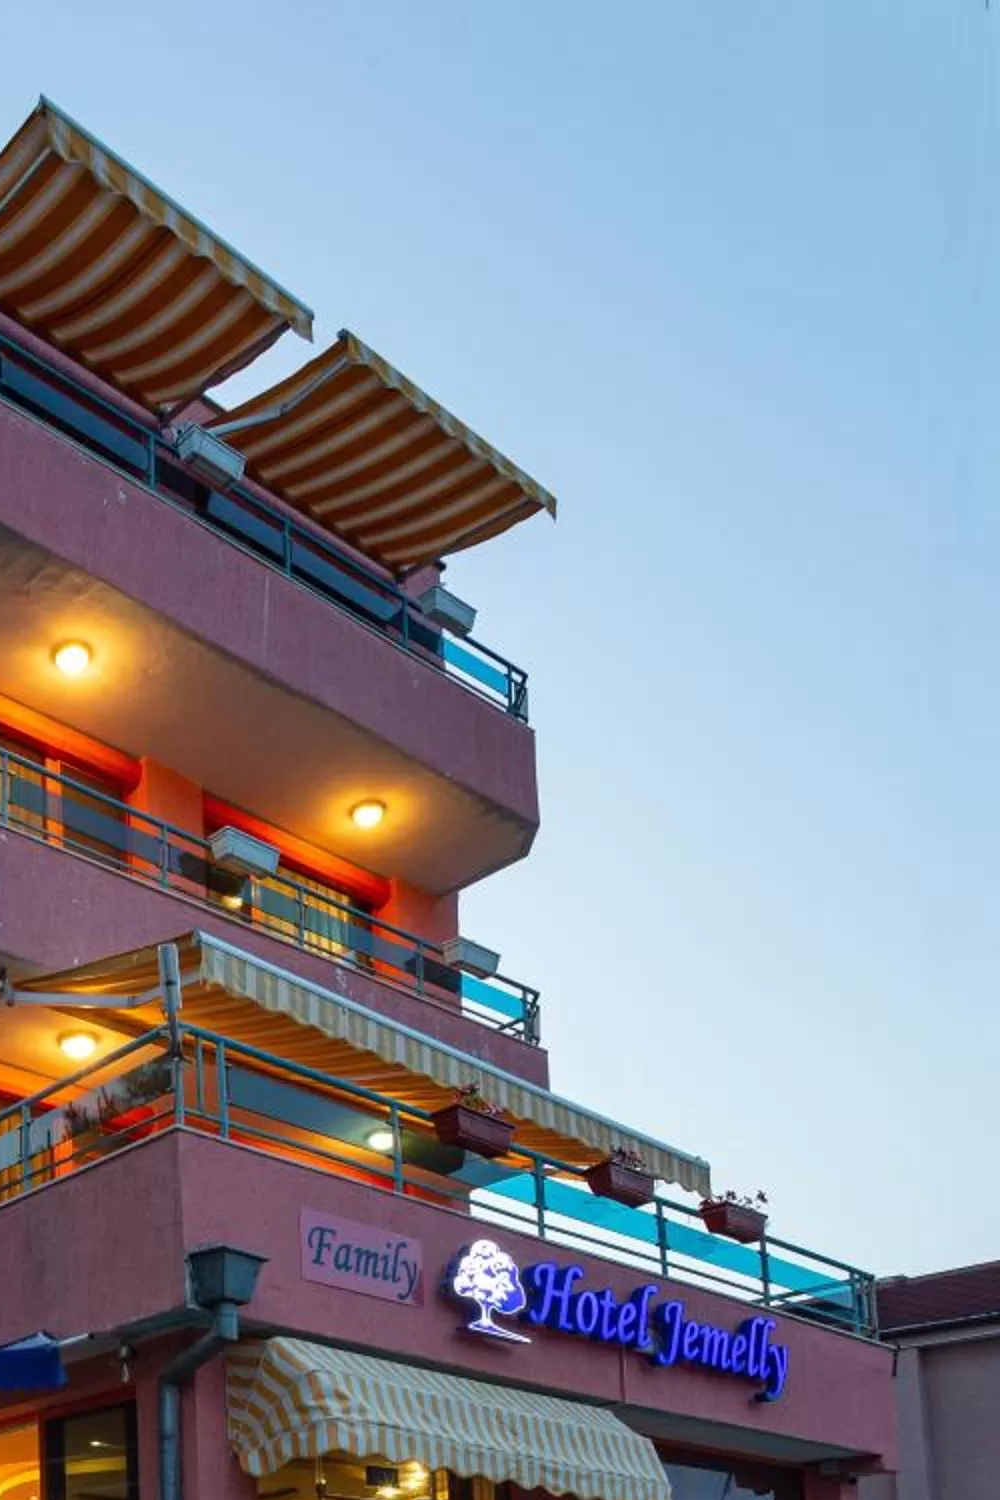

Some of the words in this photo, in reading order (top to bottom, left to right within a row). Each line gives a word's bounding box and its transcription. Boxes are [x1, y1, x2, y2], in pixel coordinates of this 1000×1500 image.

[307, 1225, 418, 1300] Family
[529, 1262, 660, 1349] Hotel
[655, 1300, 789, 1402] Jemelly
